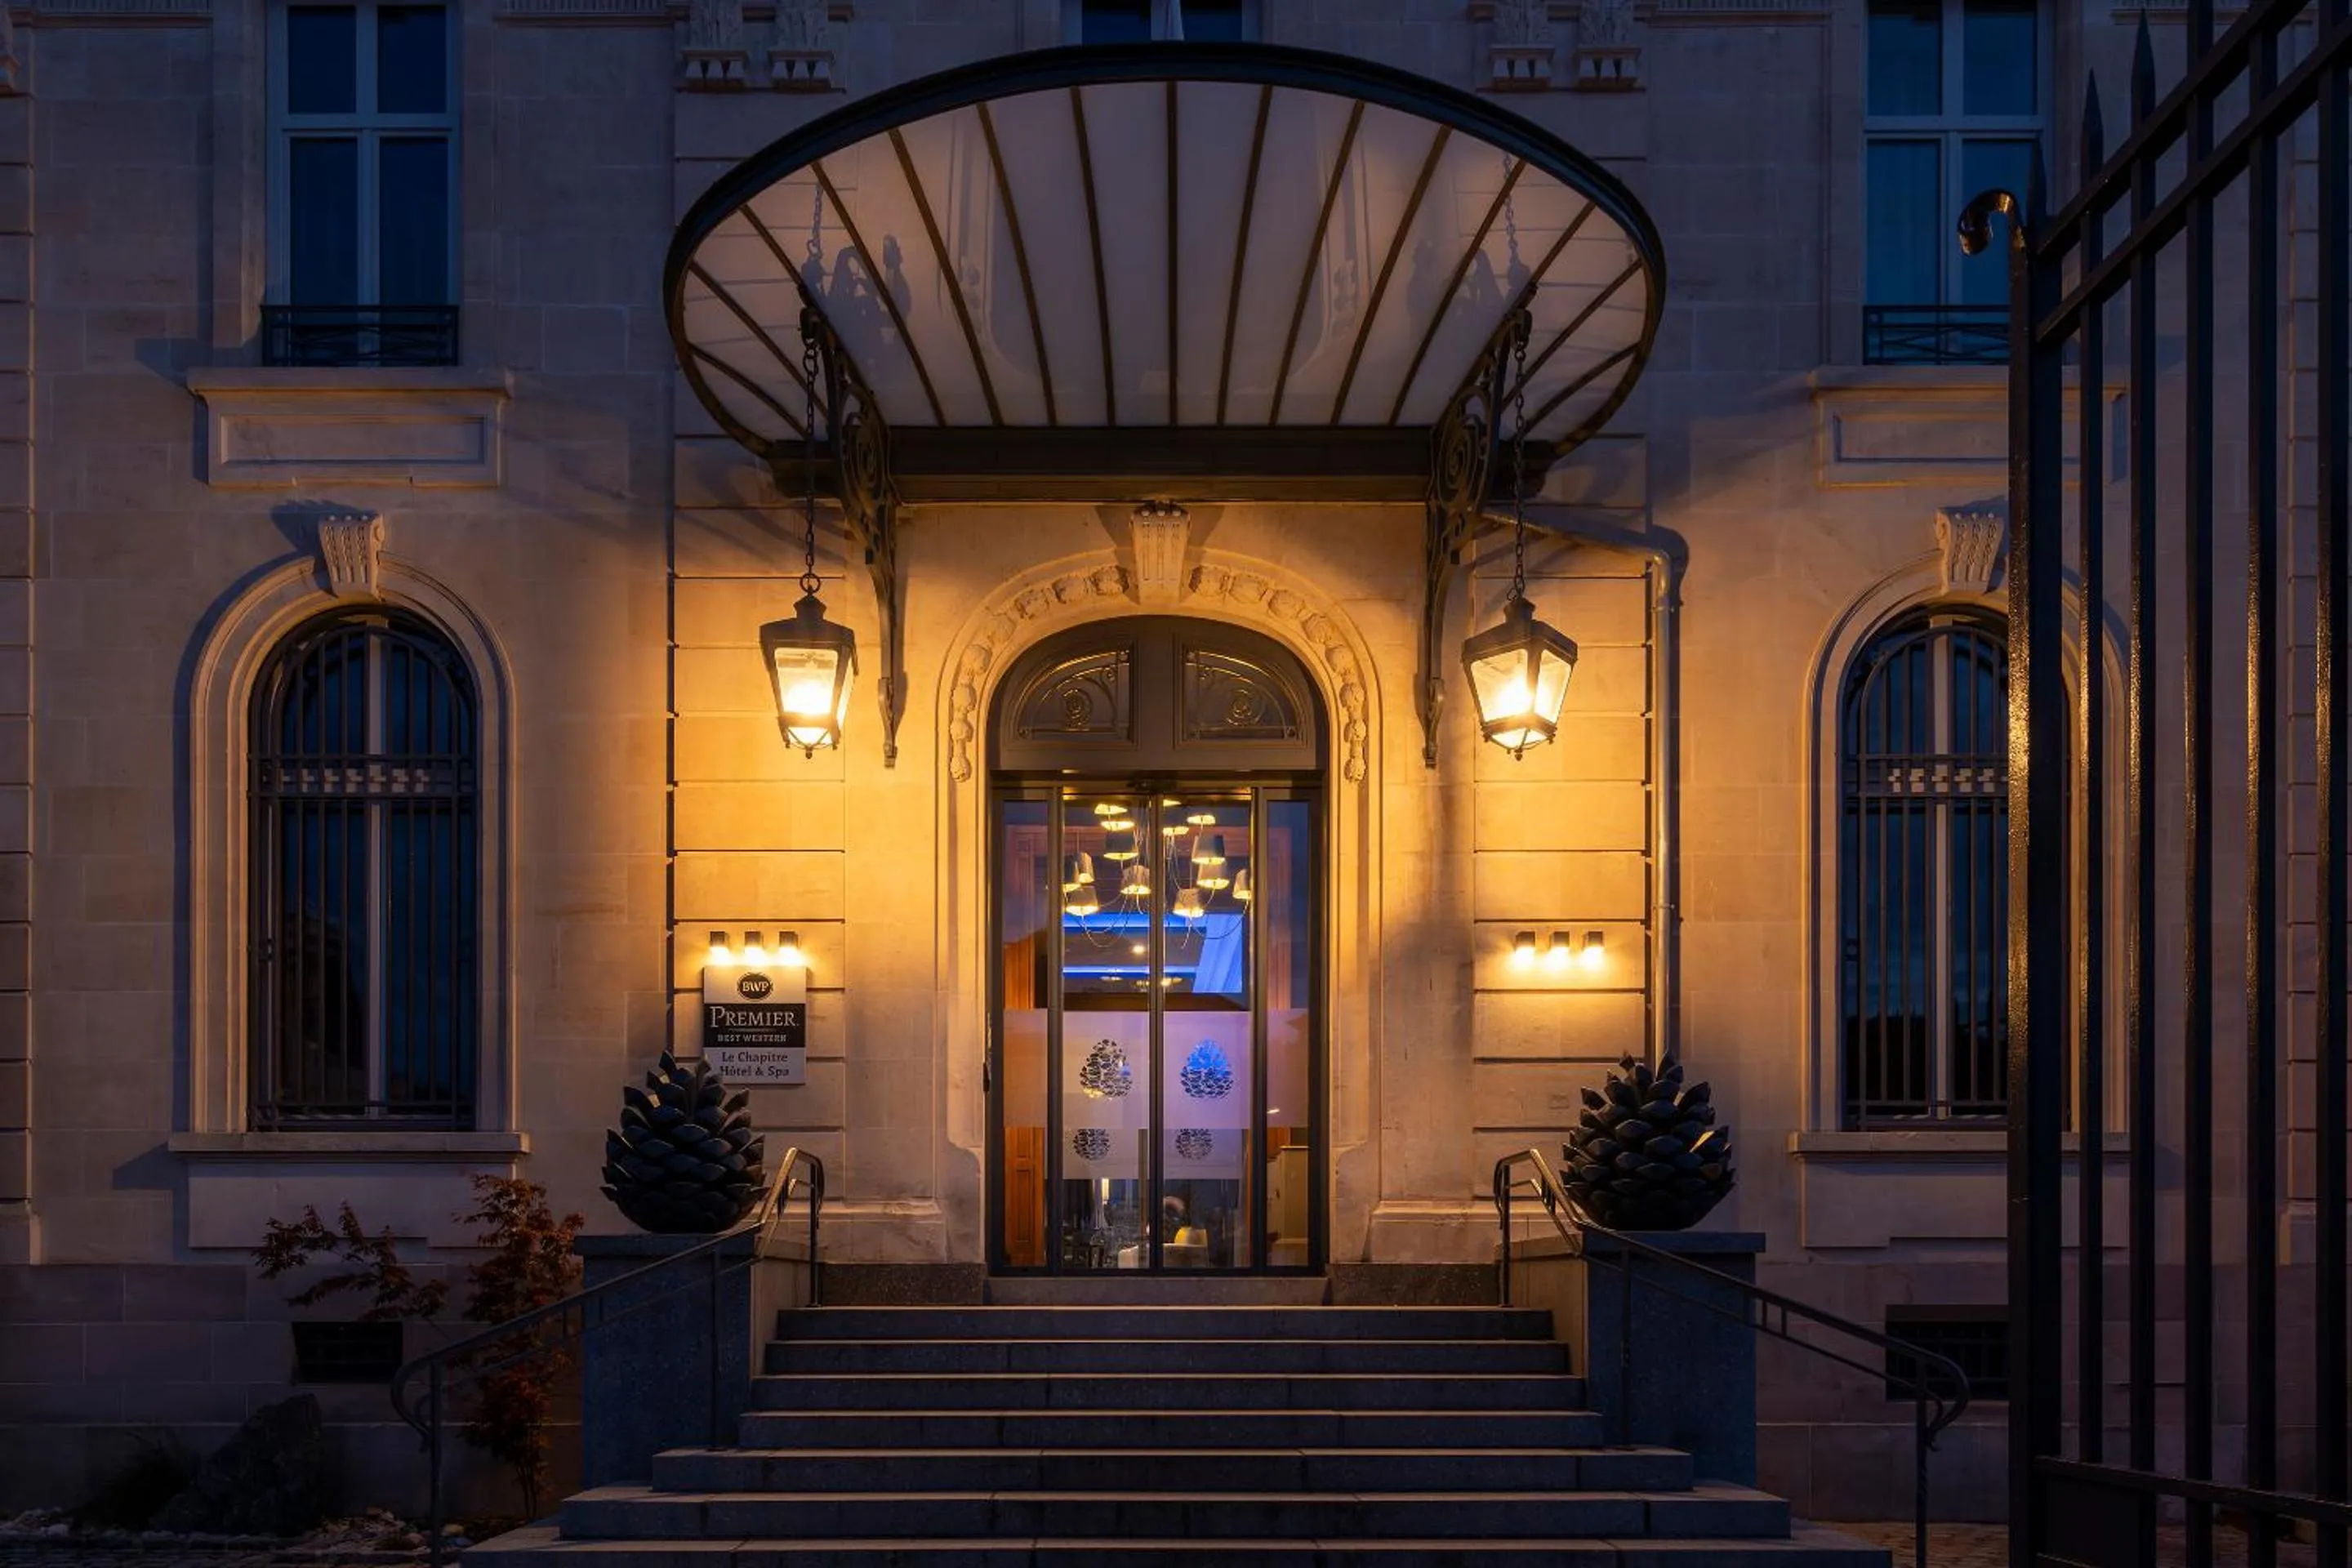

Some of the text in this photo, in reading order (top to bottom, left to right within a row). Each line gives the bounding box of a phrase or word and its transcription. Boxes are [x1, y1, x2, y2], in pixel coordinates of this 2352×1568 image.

[742, 981, 768, 992] BWP
[710, 1006, 796, 1028] PREMIER
[717, 1034, 787, 1042] BEST WESTERN
[722, 1051, 788, 1064] Le Chapitre
[720, 1065, 790, 1079] Hôtel & Spa
